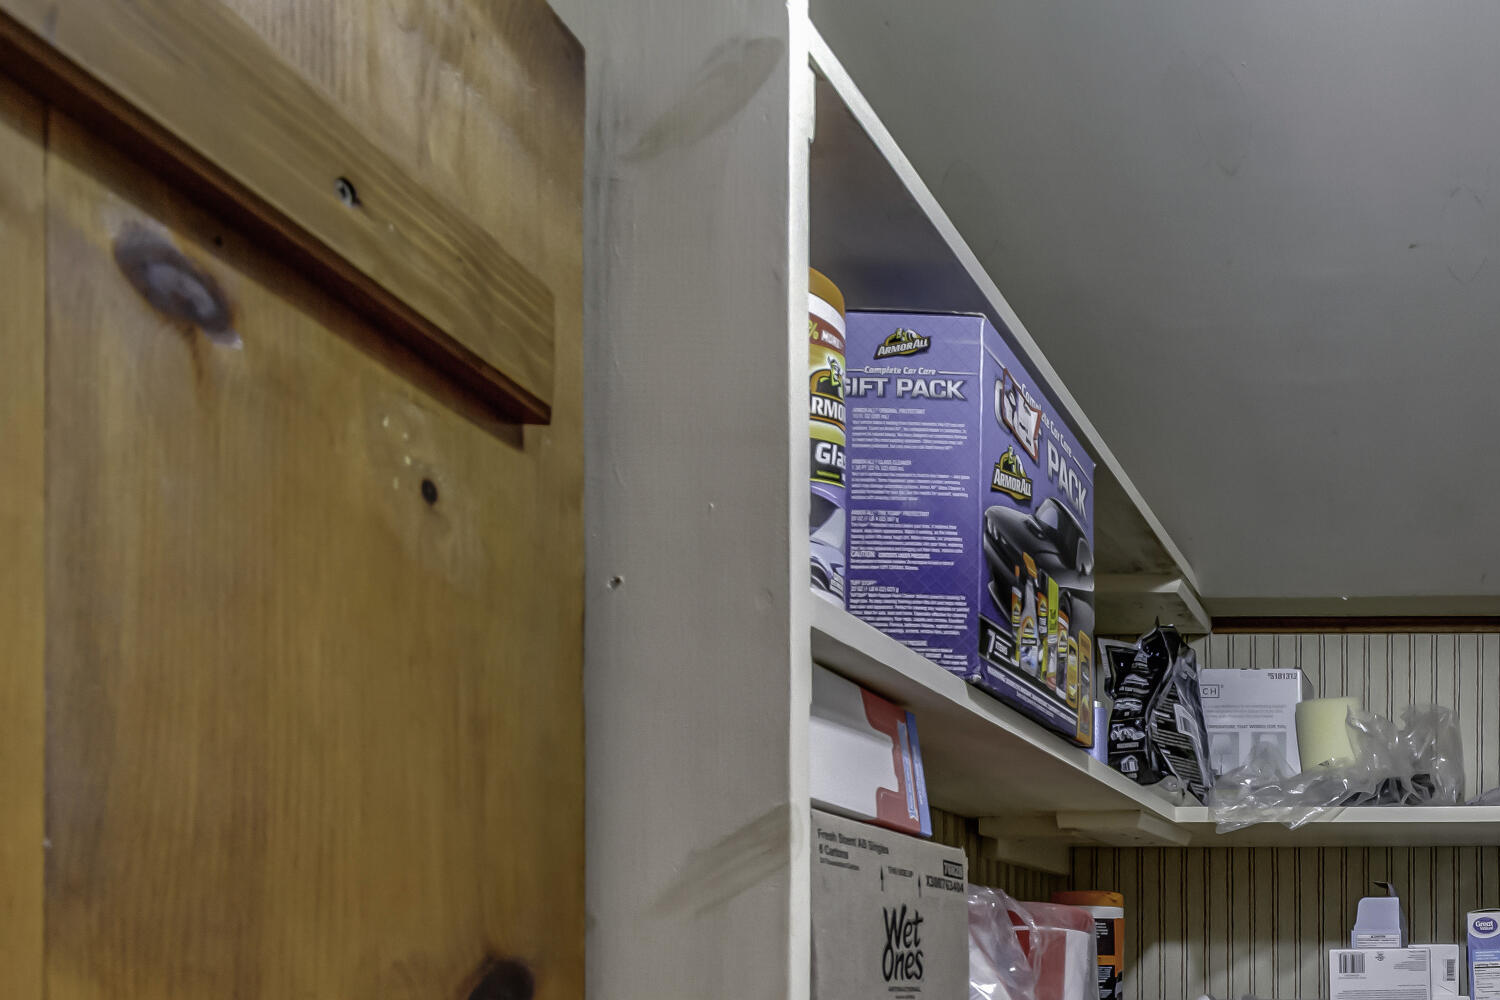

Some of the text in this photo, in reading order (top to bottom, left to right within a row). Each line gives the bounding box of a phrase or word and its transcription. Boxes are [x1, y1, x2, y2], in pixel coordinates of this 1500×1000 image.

[864, 366, 937, 377] Complete Car Care
[896, 379, 967, 400] PACK
[1047, 440, 1088, 521] PACK
[883, 903, 924, 949] Wet
[1475, 920, 1494, 928] Great
[881, 947, 924, 983] Ones
